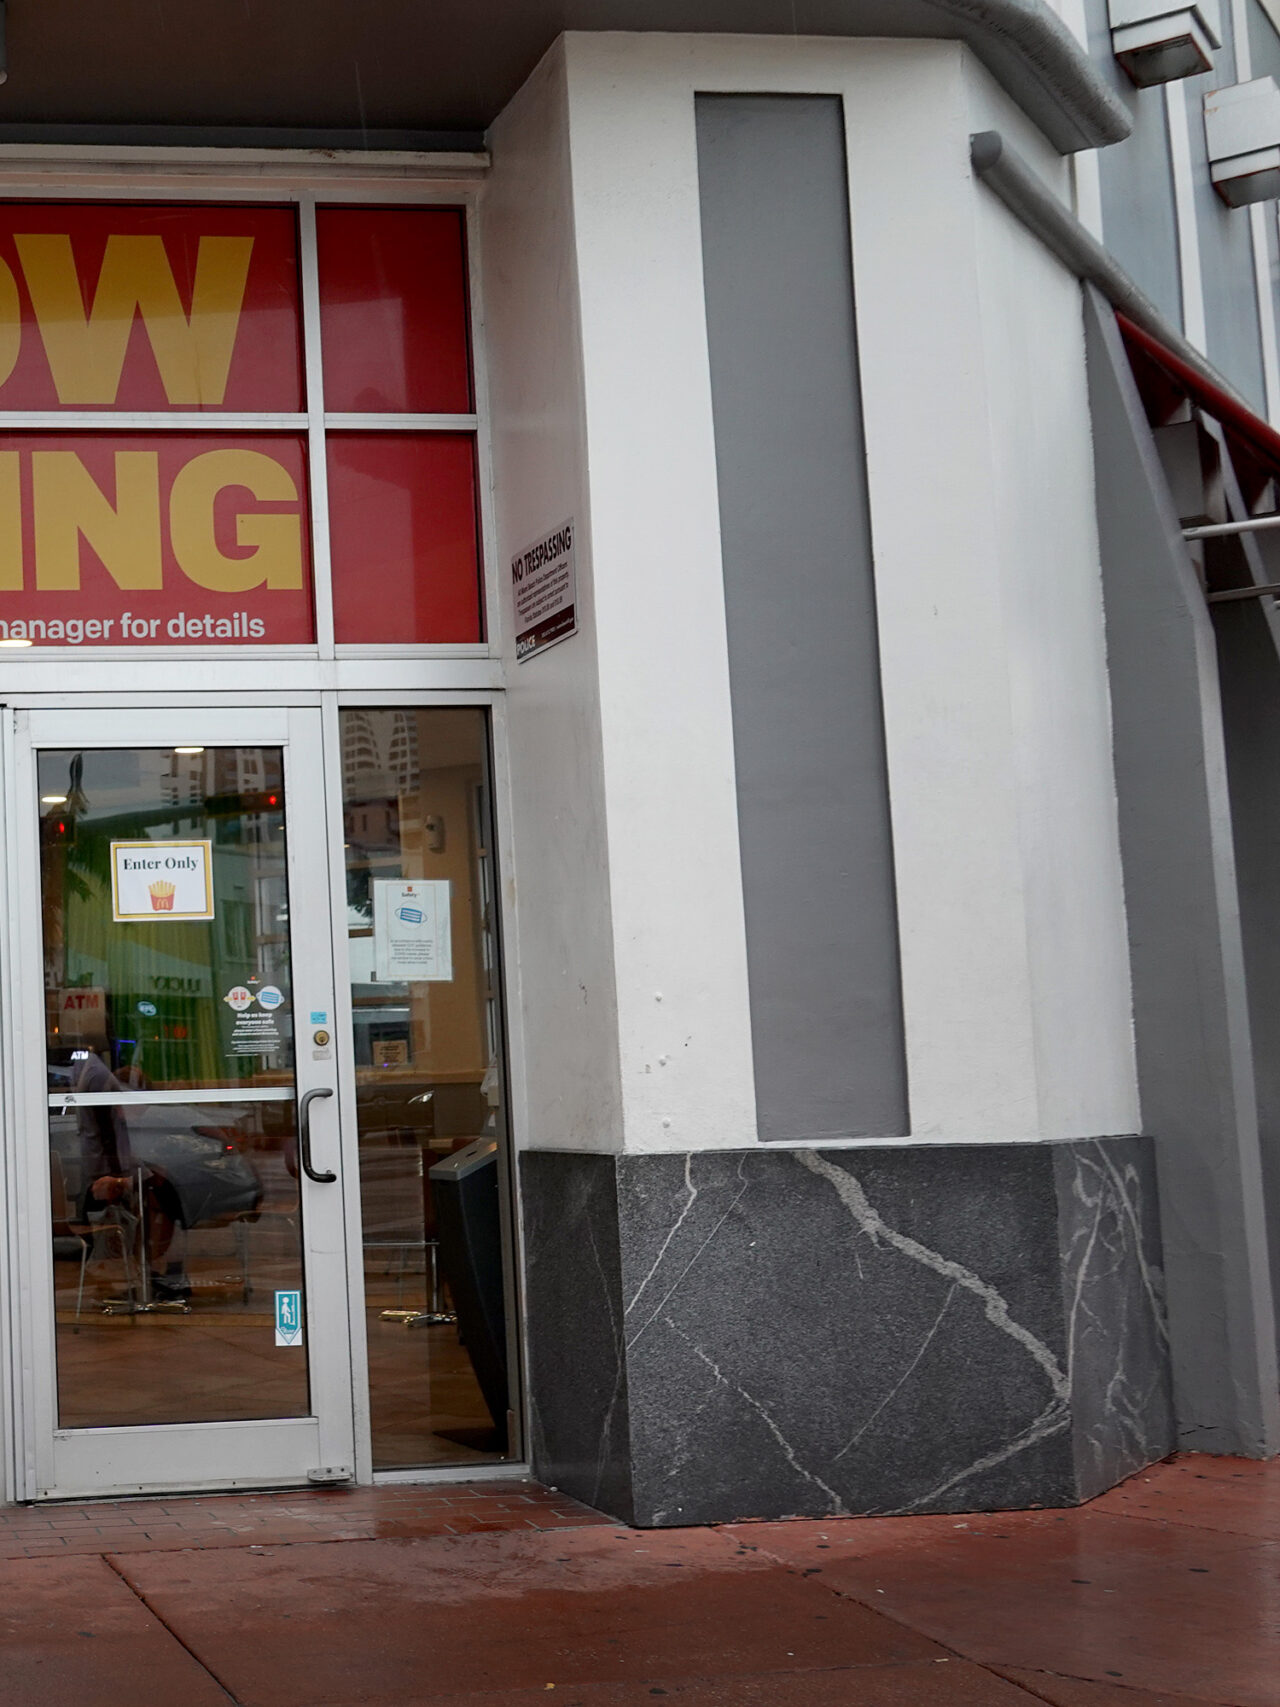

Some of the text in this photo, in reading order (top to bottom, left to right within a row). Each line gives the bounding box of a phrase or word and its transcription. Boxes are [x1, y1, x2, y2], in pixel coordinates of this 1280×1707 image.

[511, 525, 572, 585] NO TRESPASSING
[120, 611, 161, 638] for
[166, 611, 266, 638] details
[123, 856, 199, 871] Enter Only
[64, 994, 99, 1010] ATM
[70, 1050, 89, 1060] ATM
